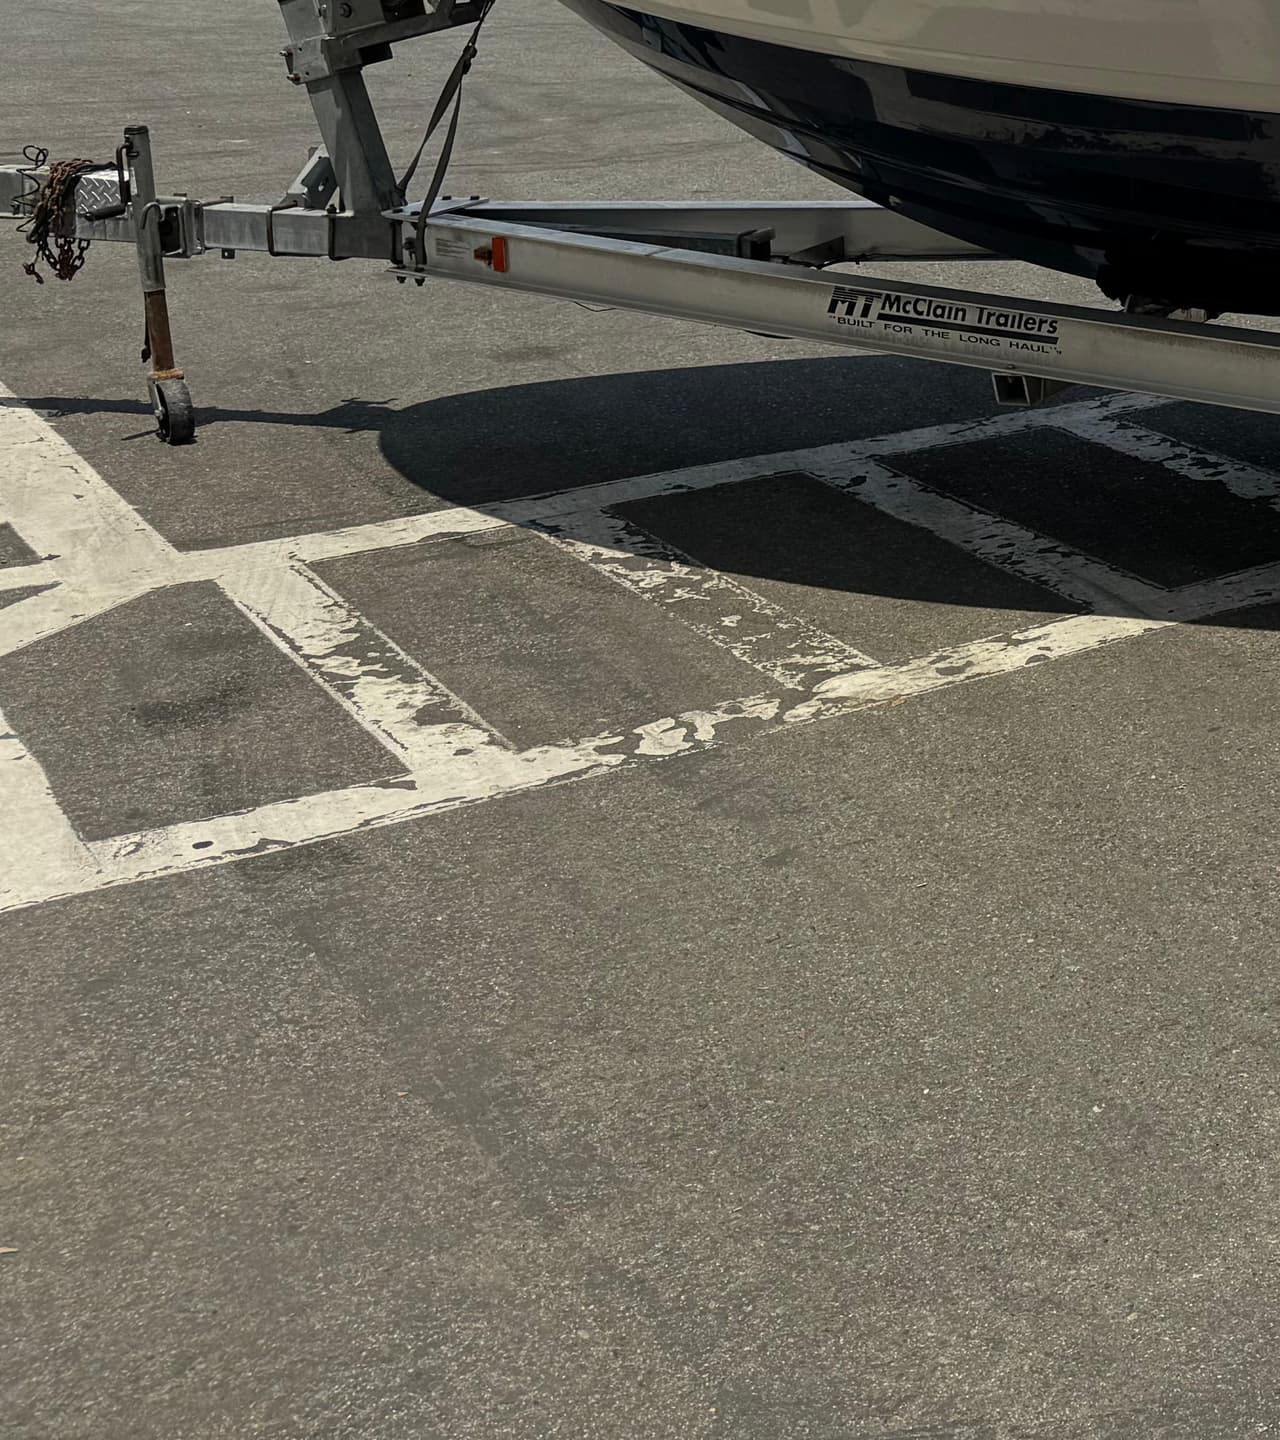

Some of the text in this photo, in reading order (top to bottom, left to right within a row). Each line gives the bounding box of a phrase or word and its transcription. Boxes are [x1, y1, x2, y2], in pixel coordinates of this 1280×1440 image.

[827, 286, 1058, 334] MT McClain Trailers
[884, 324, 913, 334] FOR
[921, 328, 950, 339] THE
[959, 334, 1001, 346] LONG
